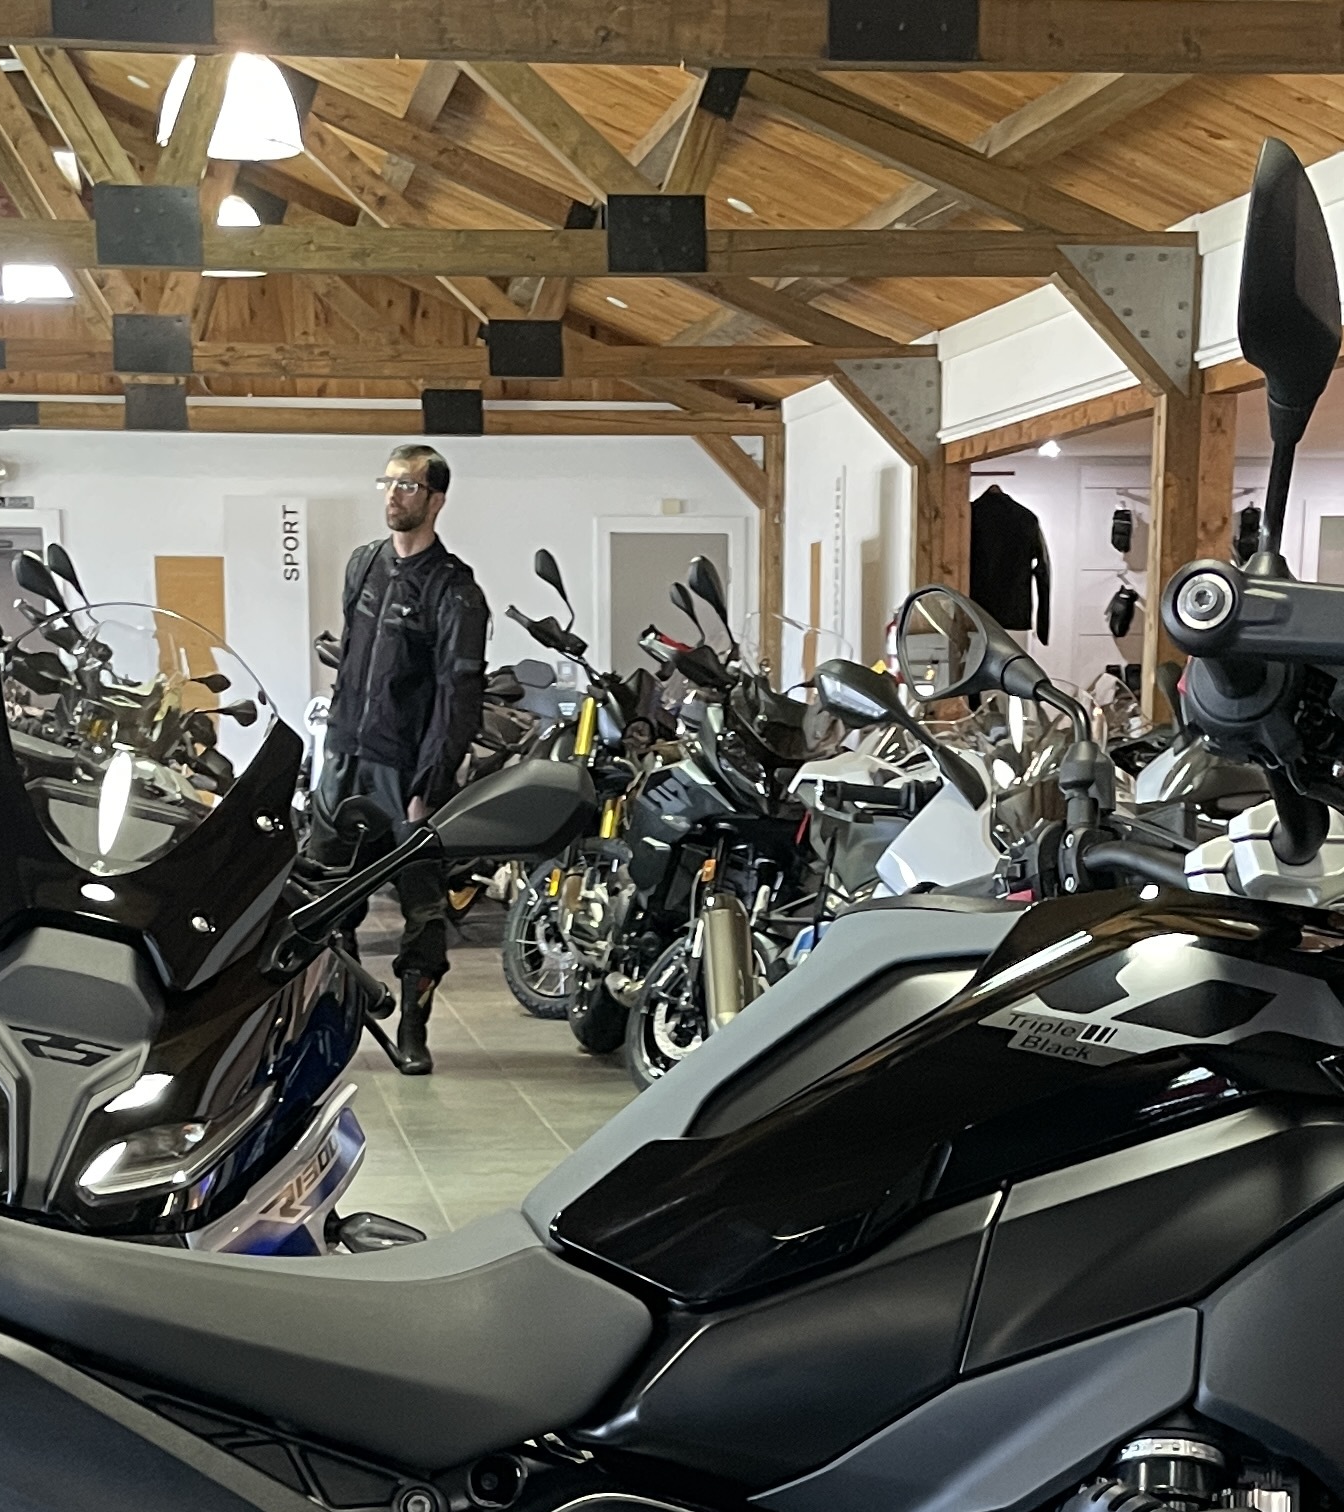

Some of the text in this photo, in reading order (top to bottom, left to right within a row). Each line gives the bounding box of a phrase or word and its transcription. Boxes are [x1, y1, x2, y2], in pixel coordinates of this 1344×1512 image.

[282, 505, 300, 581] SPORT
[1007, 1012, 1077, 1038] Triple
[1019, 1034, 1092, 1061] Black
